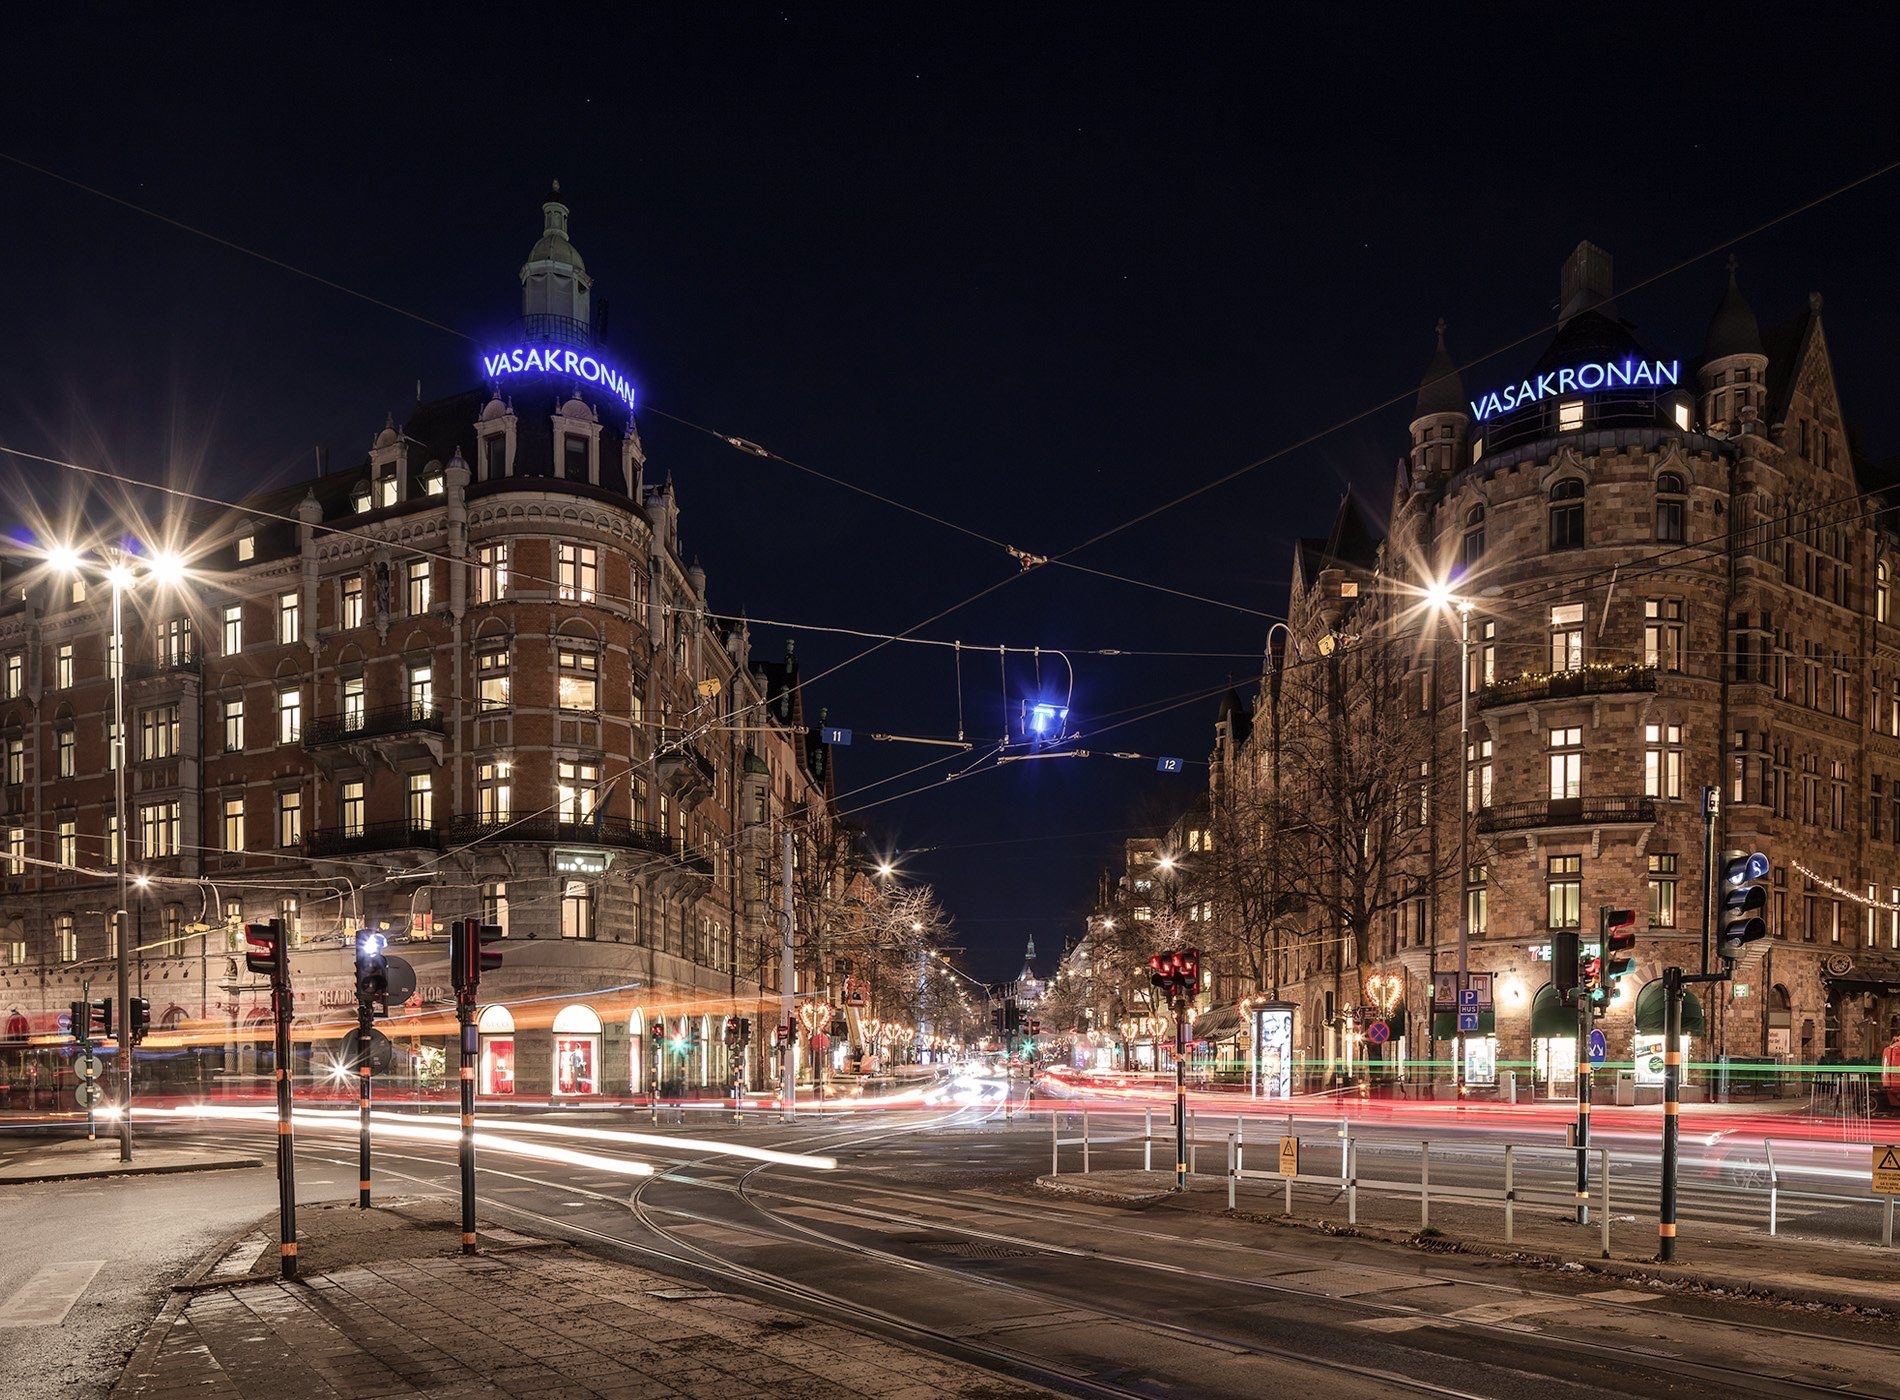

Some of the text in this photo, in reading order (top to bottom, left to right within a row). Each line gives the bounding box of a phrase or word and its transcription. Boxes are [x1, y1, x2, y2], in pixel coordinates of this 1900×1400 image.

[484, 348, 635, 410] VASAKRONAN
[1470, 360, 1678, 421] VASAKRONAN
[832, 730, 841, 741] 11
[1164, 759, 1176, 770] 12
[1465, 991, 1474, 1004] P
